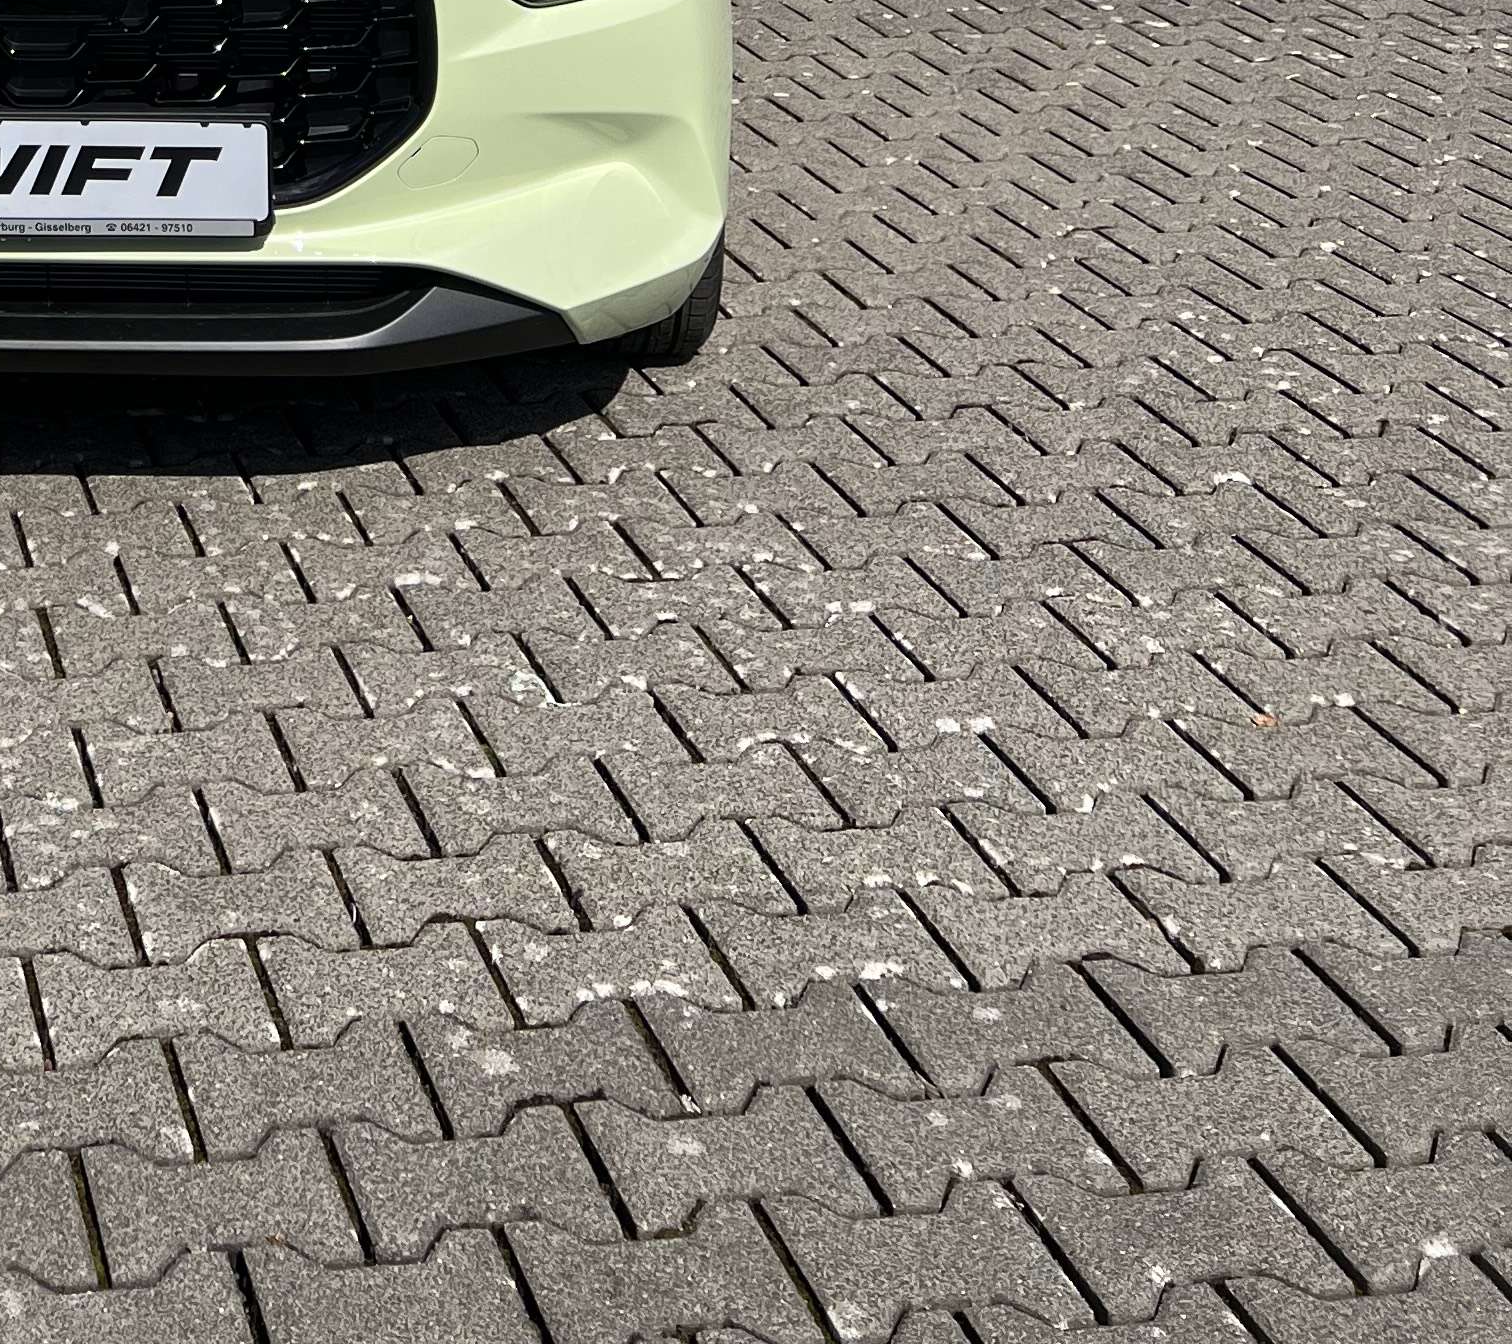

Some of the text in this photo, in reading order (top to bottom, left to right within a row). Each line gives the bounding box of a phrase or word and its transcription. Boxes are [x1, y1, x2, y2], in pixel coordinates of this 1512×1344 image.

[35, 222, 92, 234] Gisselberg
[120, 223, 151, 232] 06421
[161, 223, 193, 233] 97510
